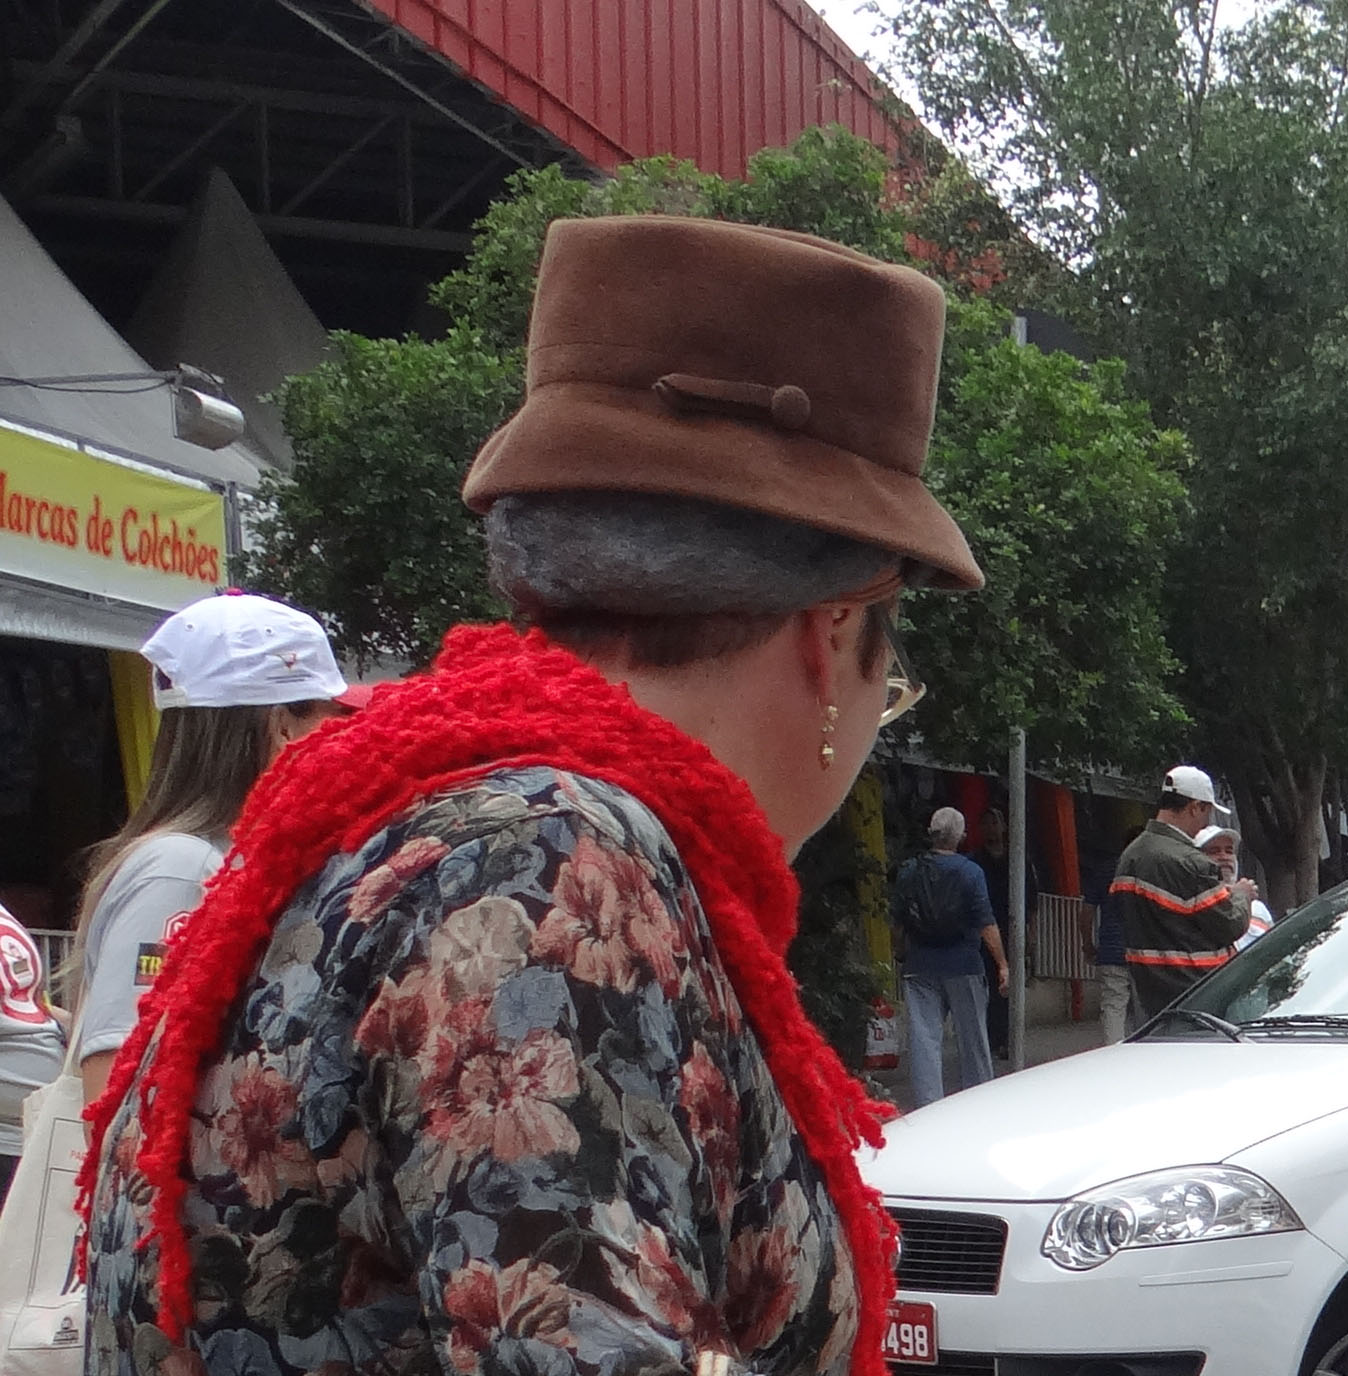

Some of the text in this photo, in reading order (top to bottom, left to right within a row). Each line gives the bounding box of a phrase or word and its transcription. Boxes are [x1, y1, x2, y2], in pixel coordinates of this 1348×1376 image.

[86, 495, 114, 557] de
[121, 508, 219, 583] Colchões
[881, 1322, 928, 1357] 498
